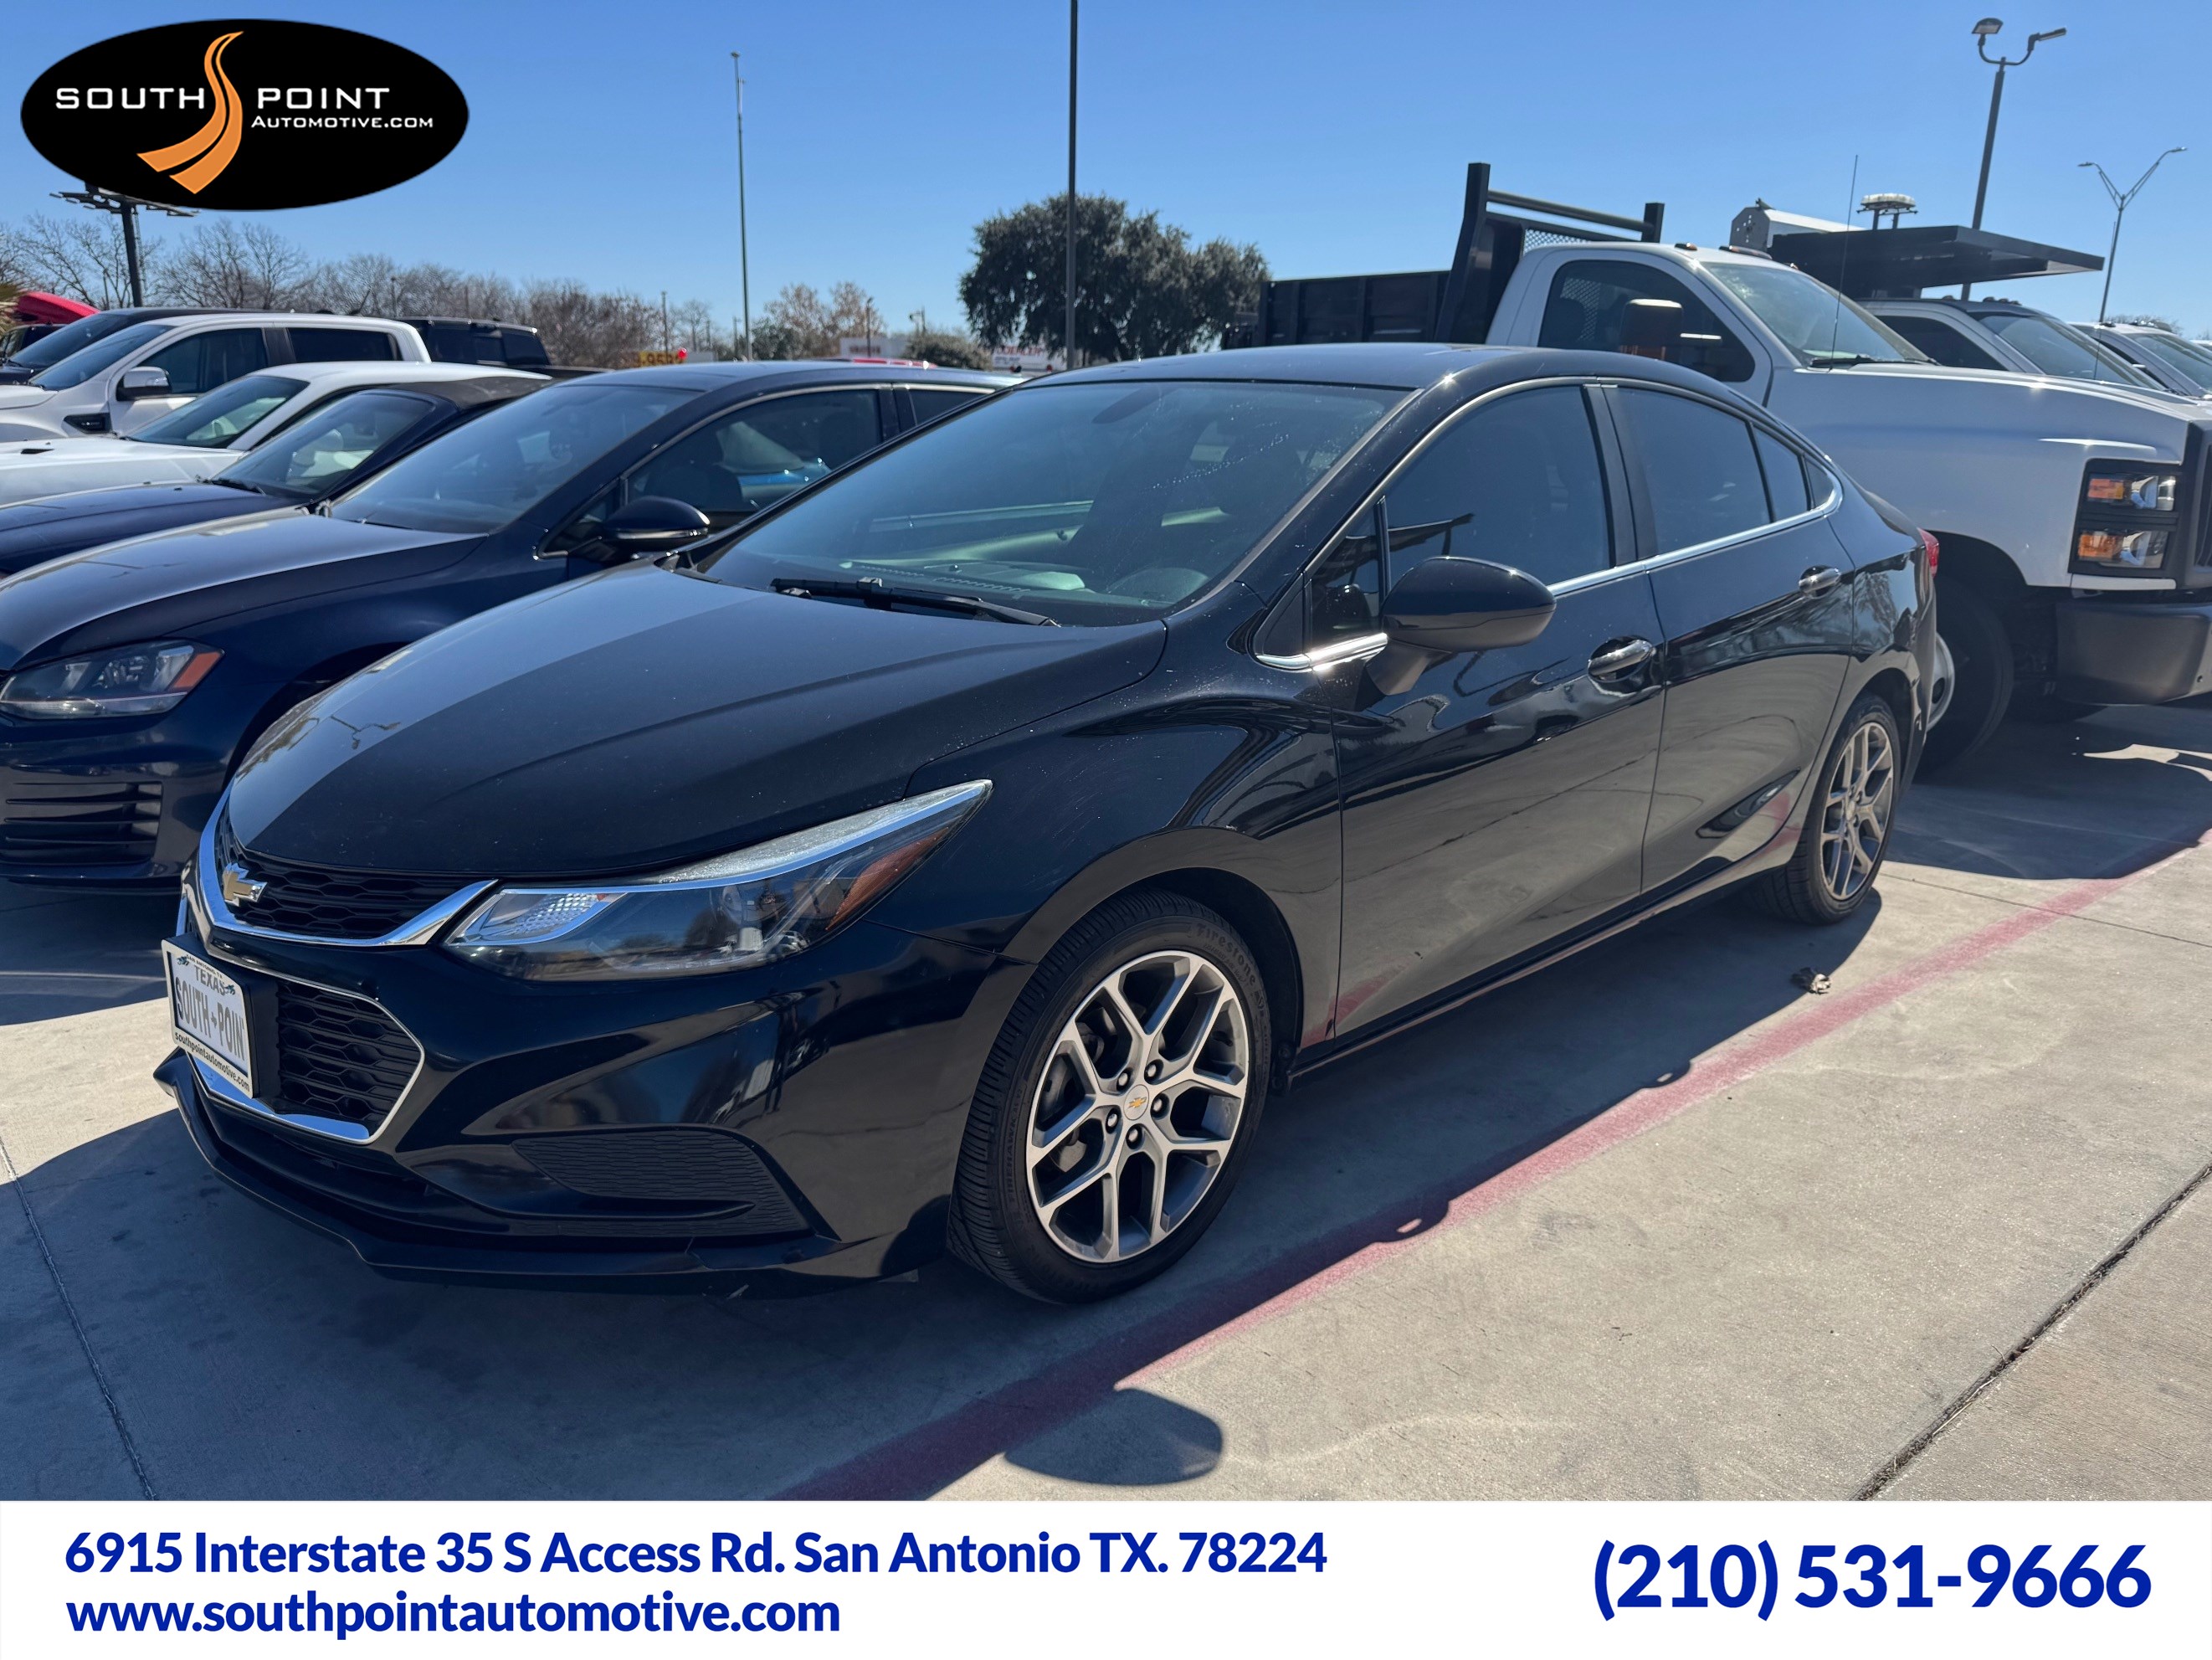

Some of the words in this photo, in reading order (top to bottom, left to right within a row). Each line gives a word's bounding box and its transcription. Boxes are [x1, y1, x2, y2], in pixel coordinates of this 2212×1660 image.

[194, 964, 226, 996] TEXAS
[1196, 923, 1255, 986] Firestone
[175, 976, 211, 1039] SOUTH
[175, 1031, 250, 1093] southpointautomotive.com
